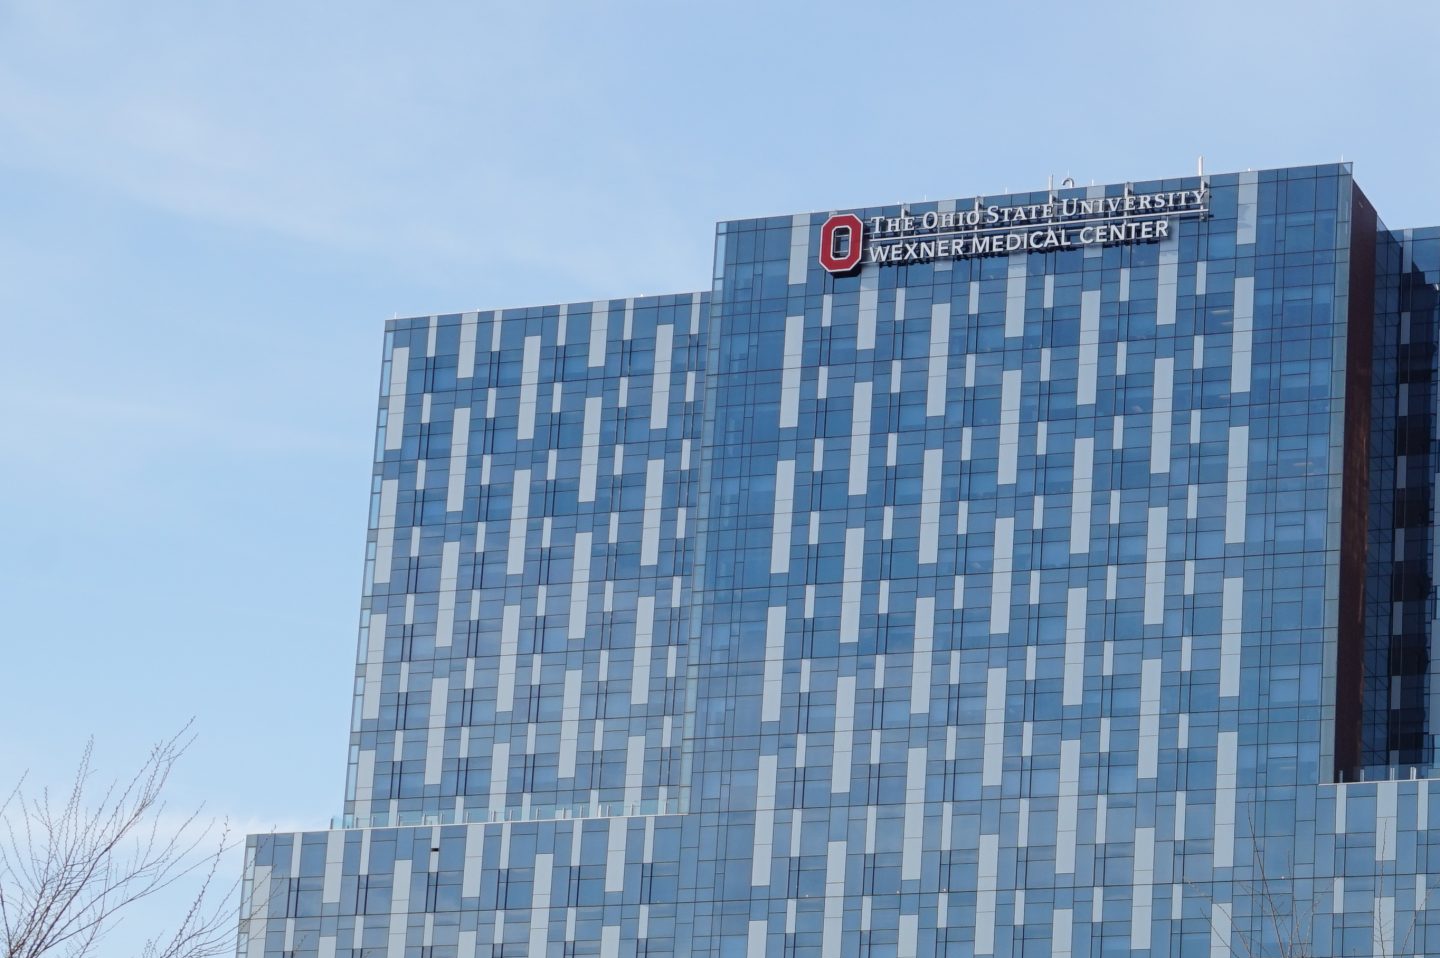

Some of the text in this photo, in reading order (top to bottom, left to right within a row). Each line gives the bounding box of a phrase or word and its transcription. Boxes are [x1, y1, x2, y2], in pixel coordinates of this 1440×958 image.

[871, 190, 1206, 234] THE OHIO STATE UNIVERSITY
[870, 220, 1168, 262] WEXNER MEDICAL CENTER
